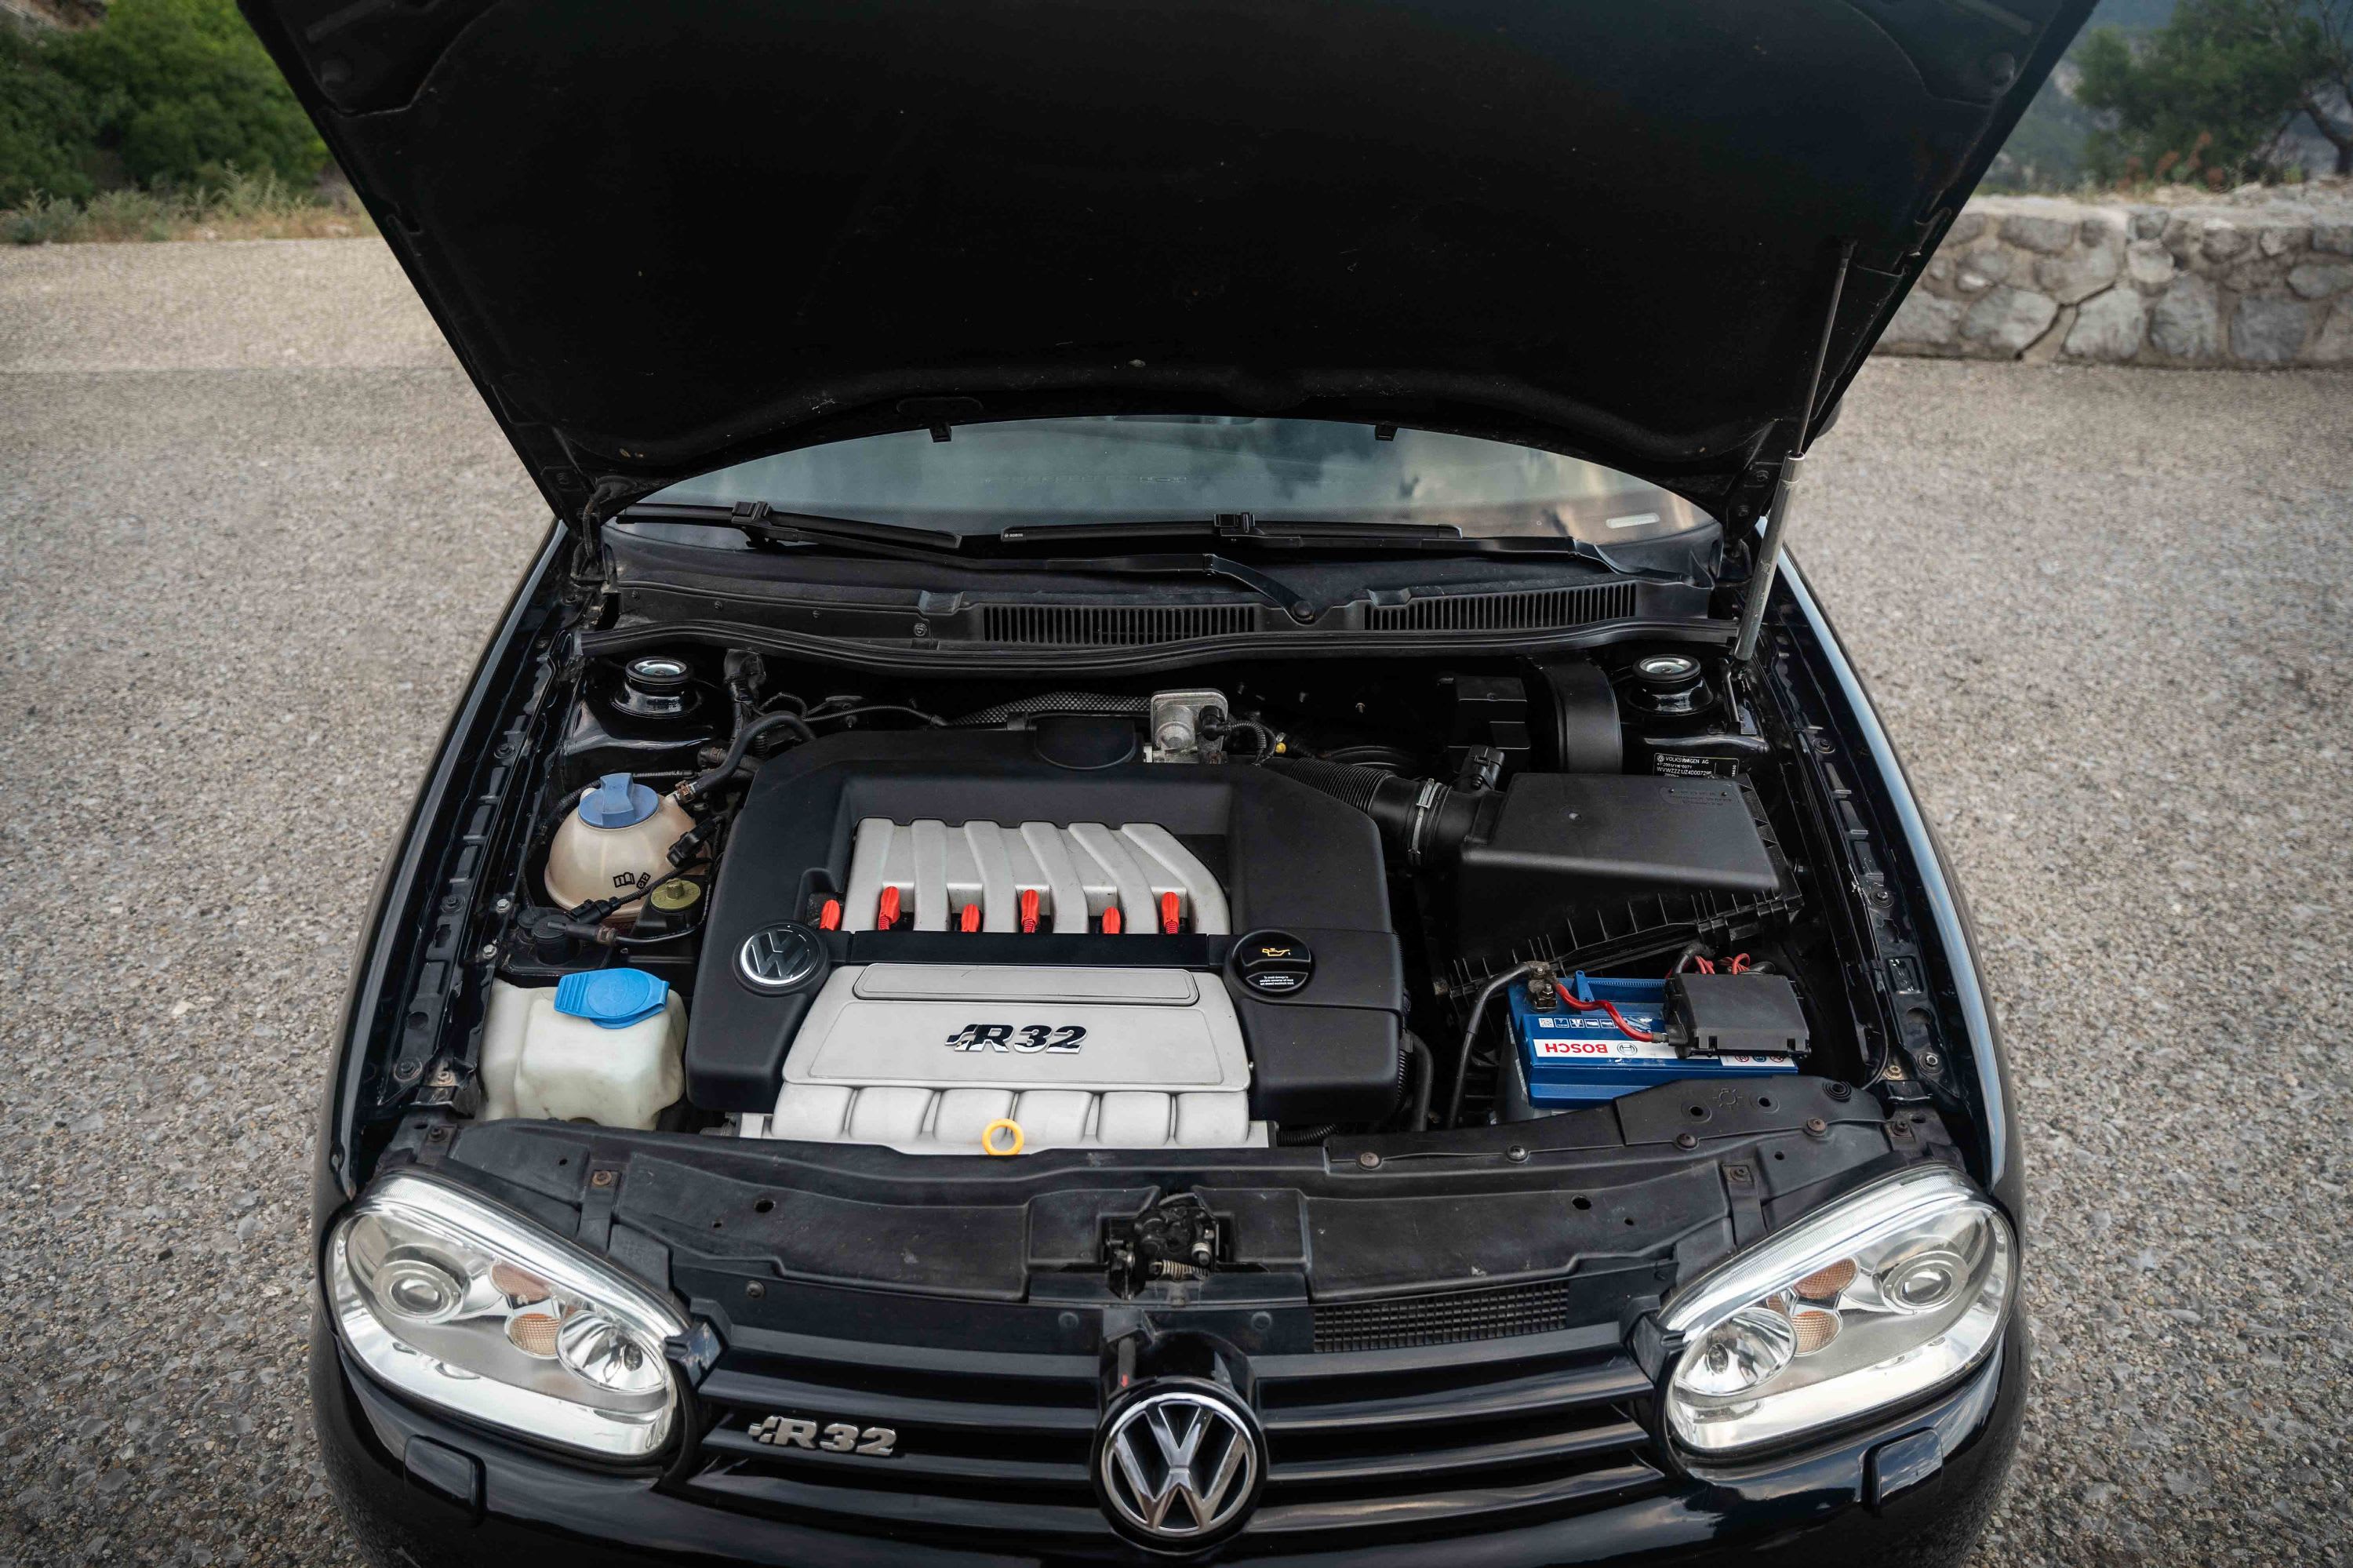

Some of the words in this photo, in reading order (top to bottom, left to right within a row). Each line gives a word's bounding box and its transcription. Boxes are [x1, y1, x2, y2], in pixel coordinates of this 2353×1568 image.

[638, 874, 649, 888] G12
[946, 1024, 1087, 1053] R32
[1544, 1042, 1608, 1053] BOSCH
[748, 1415, 897, 1457] R32
